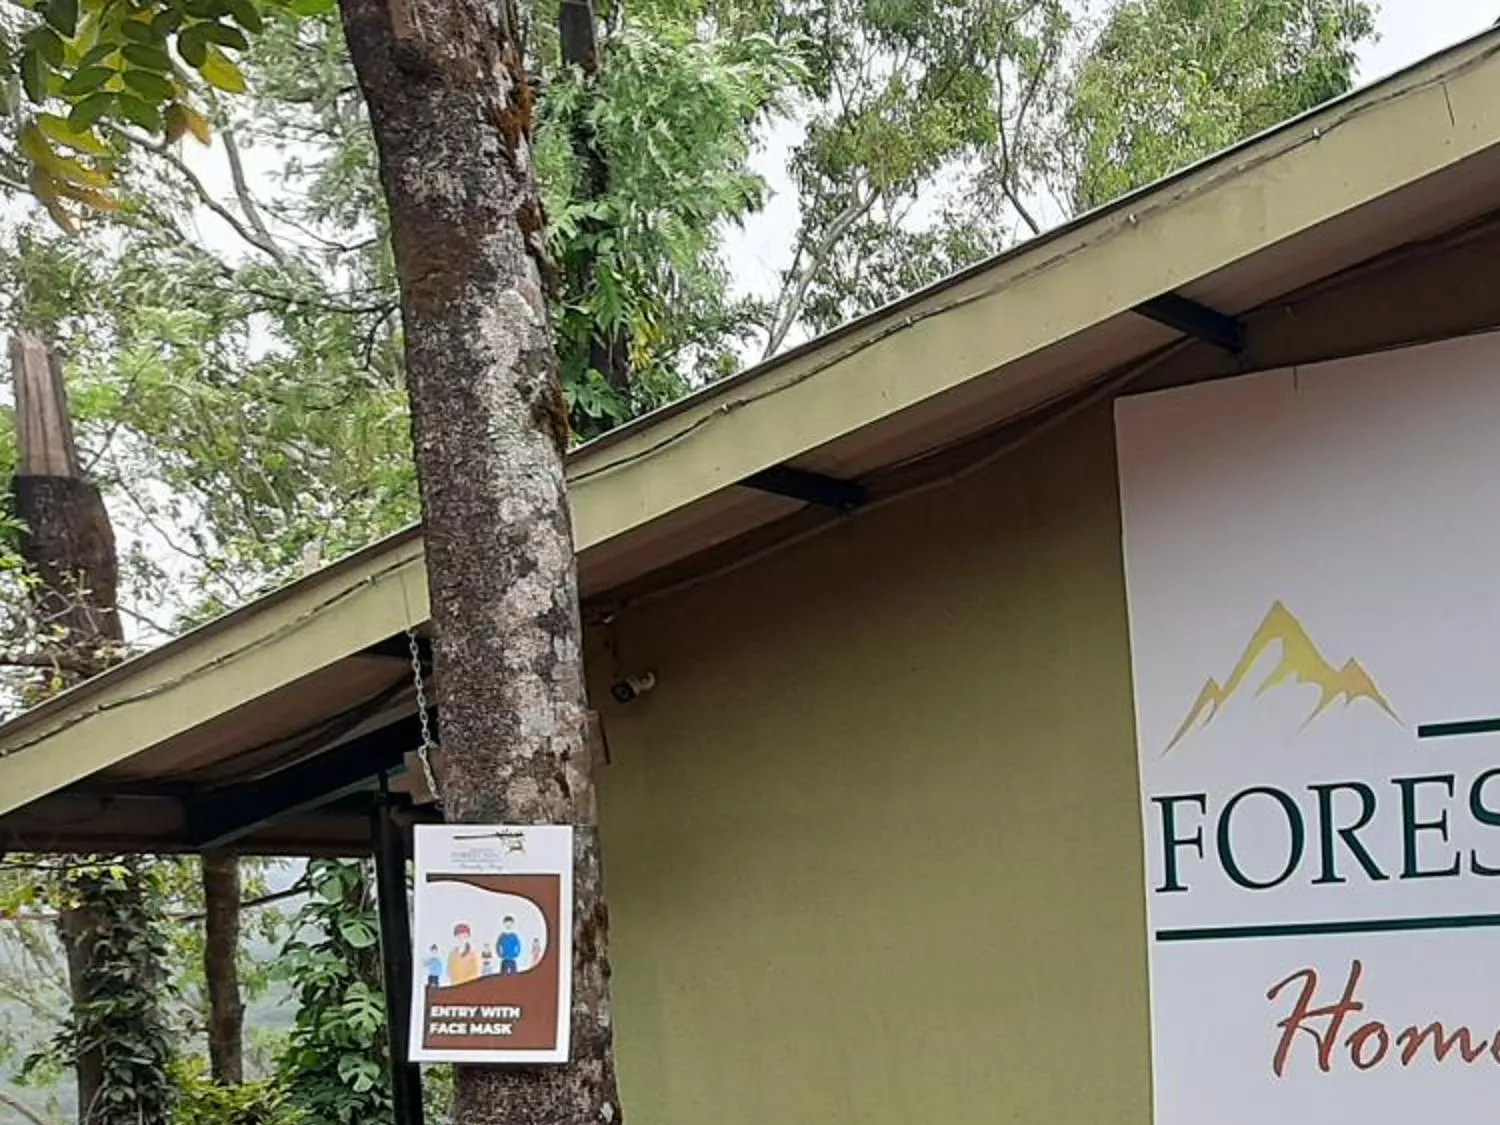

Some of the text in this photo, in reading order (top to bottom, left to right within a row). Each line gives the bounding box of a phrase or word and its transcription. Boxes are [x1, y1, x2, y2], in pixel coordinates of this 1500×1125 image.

[431, 1006, 520, 1018] ENTRY WITH
[430, 1023, 512, 1034] FACE MASK
